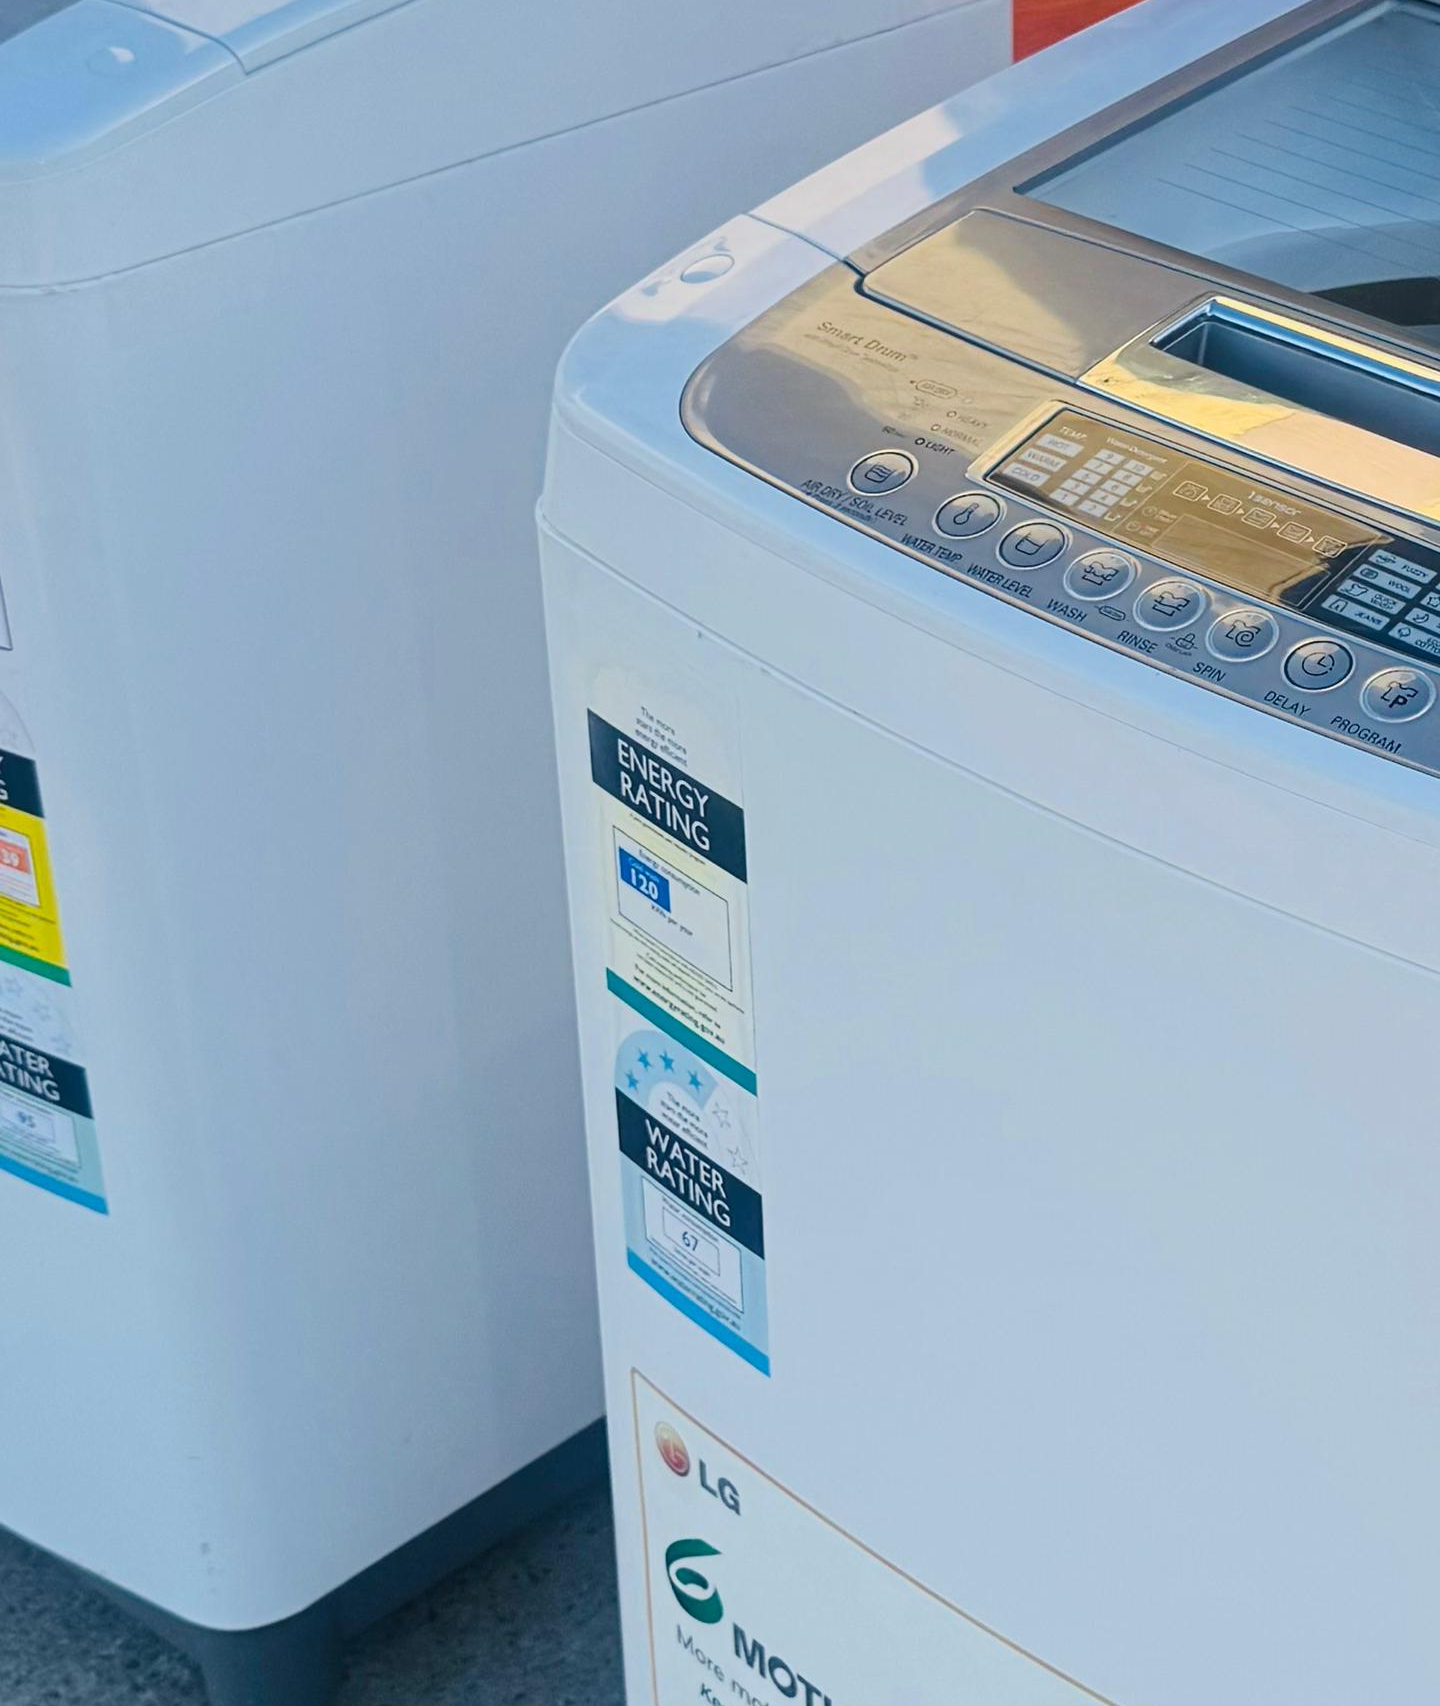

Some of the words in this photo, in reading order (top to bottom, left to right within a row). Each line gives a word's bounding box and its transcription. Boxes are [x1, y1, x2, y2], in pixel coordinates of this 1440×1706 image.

[925, 440, 956, 456] LIGHT
[874, 505, 909, 527] LEVEL
[901, 532, 938, 555] WATER
[936, 544, 963, 565] TEMP
[966, 562, 1003, 587] WATER
[999, 575, 1034, 599] LEVEL
[1400, 563, 1430, 579] FUZZY
[1047, 599, 1088, 623] WASH
[1117, 629, 1159, 654] RINSE
[1192, 661, 1228, 683] SPIN
[1263, 689, 1311, 718] DELAY
[1330, 714, 1402, 754] PROGRAM
[617, 737, 709, 818] ENERGY
[620, 770, 710, 851] RATING
[630, 868, 659, 901] 120
[644, 1118, 727, 1199] WATER
[646, 1146, 731, 1228] RATING
[681, 1230, 699, 1252] 67
[698, 1458, 742, 1517] LG
[664, 1538, 724, 1625] 6
[676, 1623, 726, 1682] More
